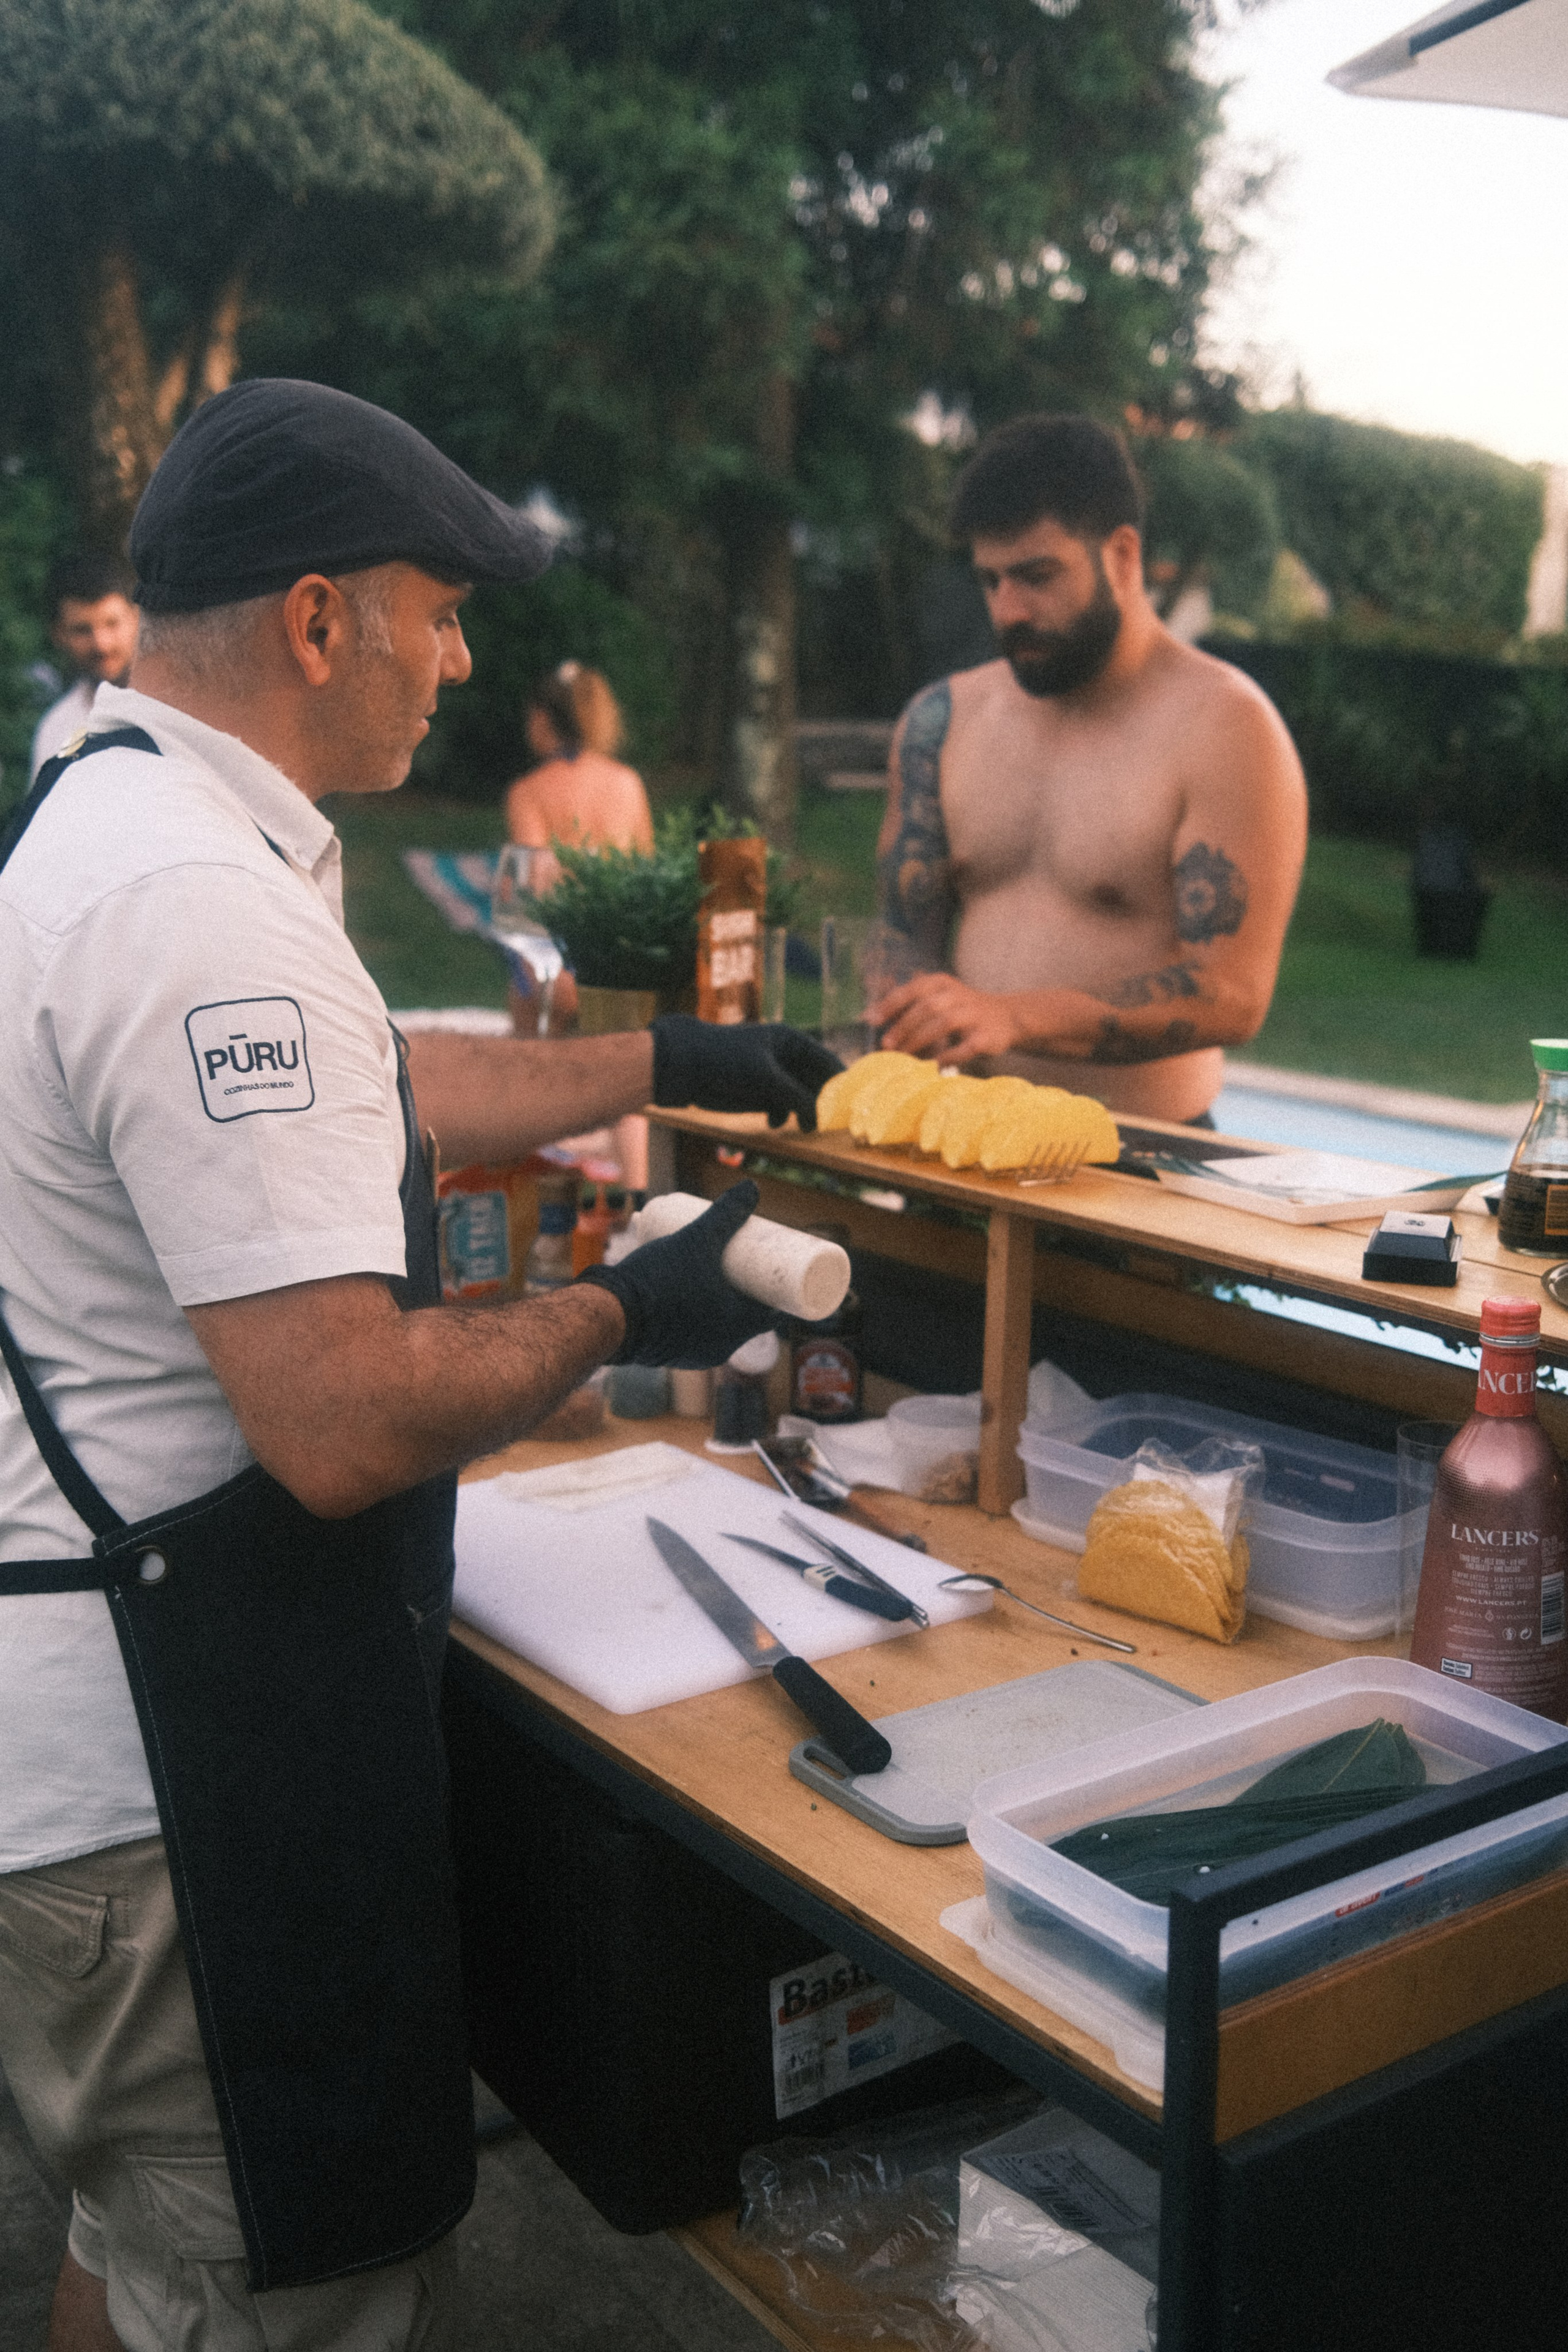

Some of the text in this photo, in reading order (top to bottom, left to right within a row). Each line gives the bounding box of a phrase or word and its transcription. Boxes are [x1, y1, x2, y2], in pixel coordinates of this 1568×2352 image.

[203, 1033, 299, 1080] PŪRU
[224, 1083, 260, 1095] COZINHAS
[1451, 1523, 1540, 1547] LANCERS
